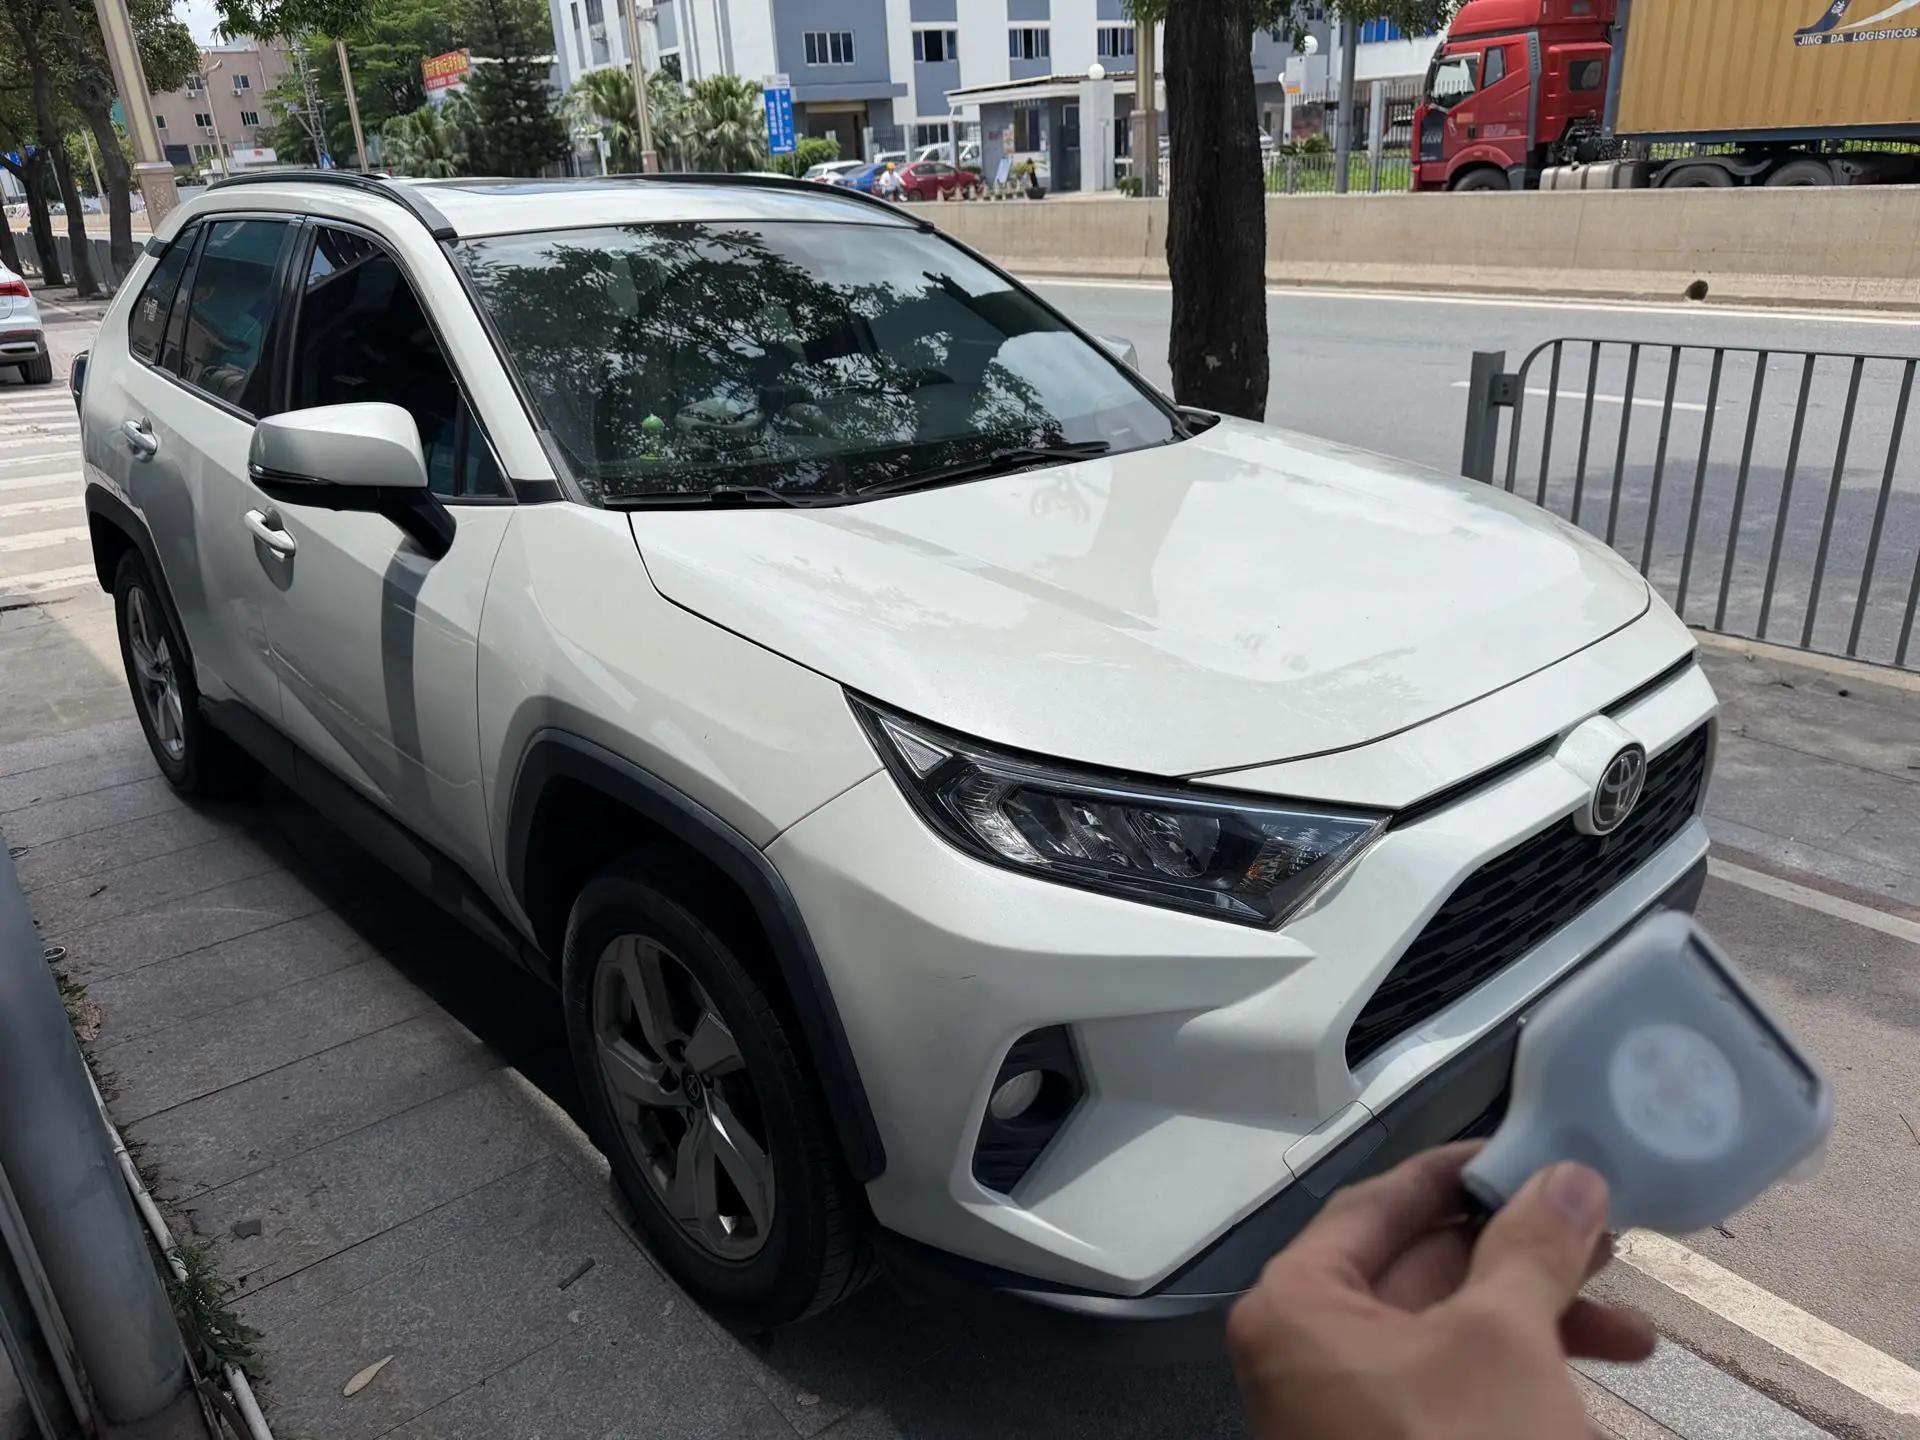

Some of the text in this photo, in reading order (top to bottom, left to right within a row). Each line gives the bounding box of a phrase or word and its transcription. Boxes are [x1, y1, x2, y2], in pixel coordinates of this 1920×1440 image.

[1798, 28, 1918, 45] JING DA LOGISTICOS
